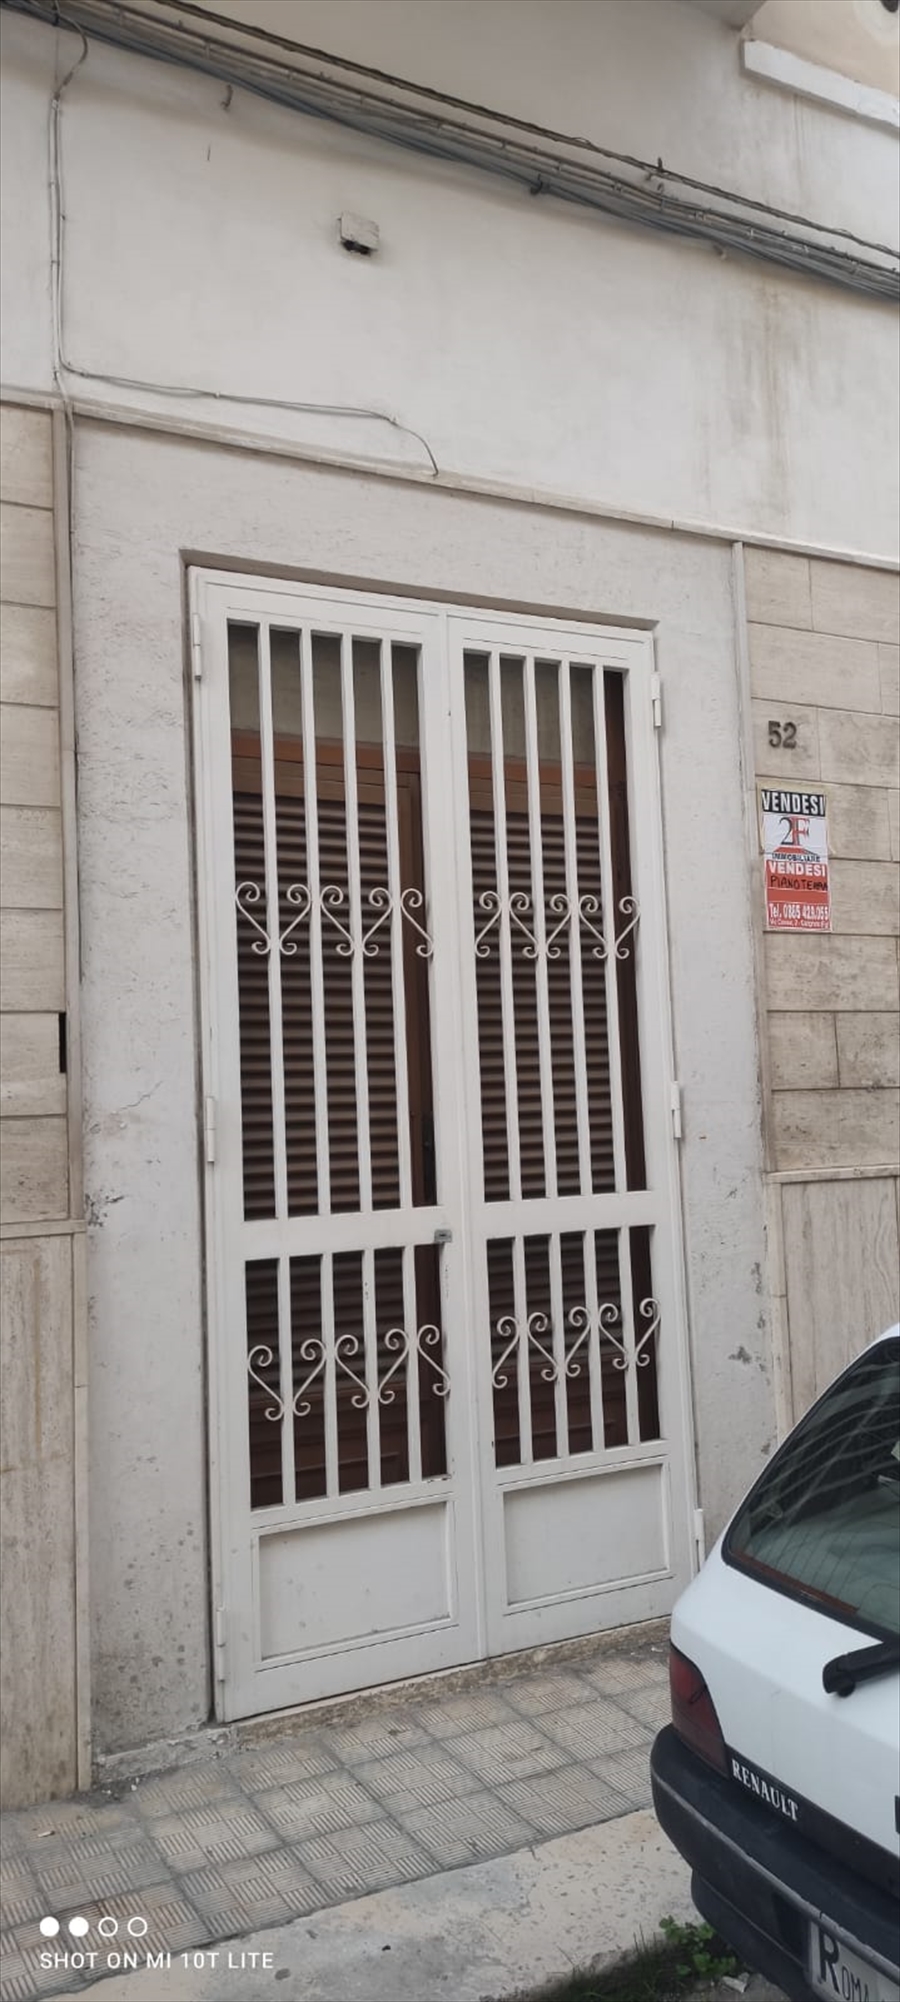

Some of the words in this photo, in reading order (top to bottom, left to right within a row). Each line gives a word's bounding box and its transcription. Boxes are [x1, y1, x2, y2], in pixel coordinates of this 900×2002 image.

[768, 720, 797, 749] 52
[762, 791, 825, 816] VENDESI
[779, 815, 811, 847] 2F
[768, 860, 827, 878] VENDESI
[770, 875, 801, 890] PIANO
[769, 902, 782, 919] Tel.
[731, 1758, 799, 1822] RENAULT
